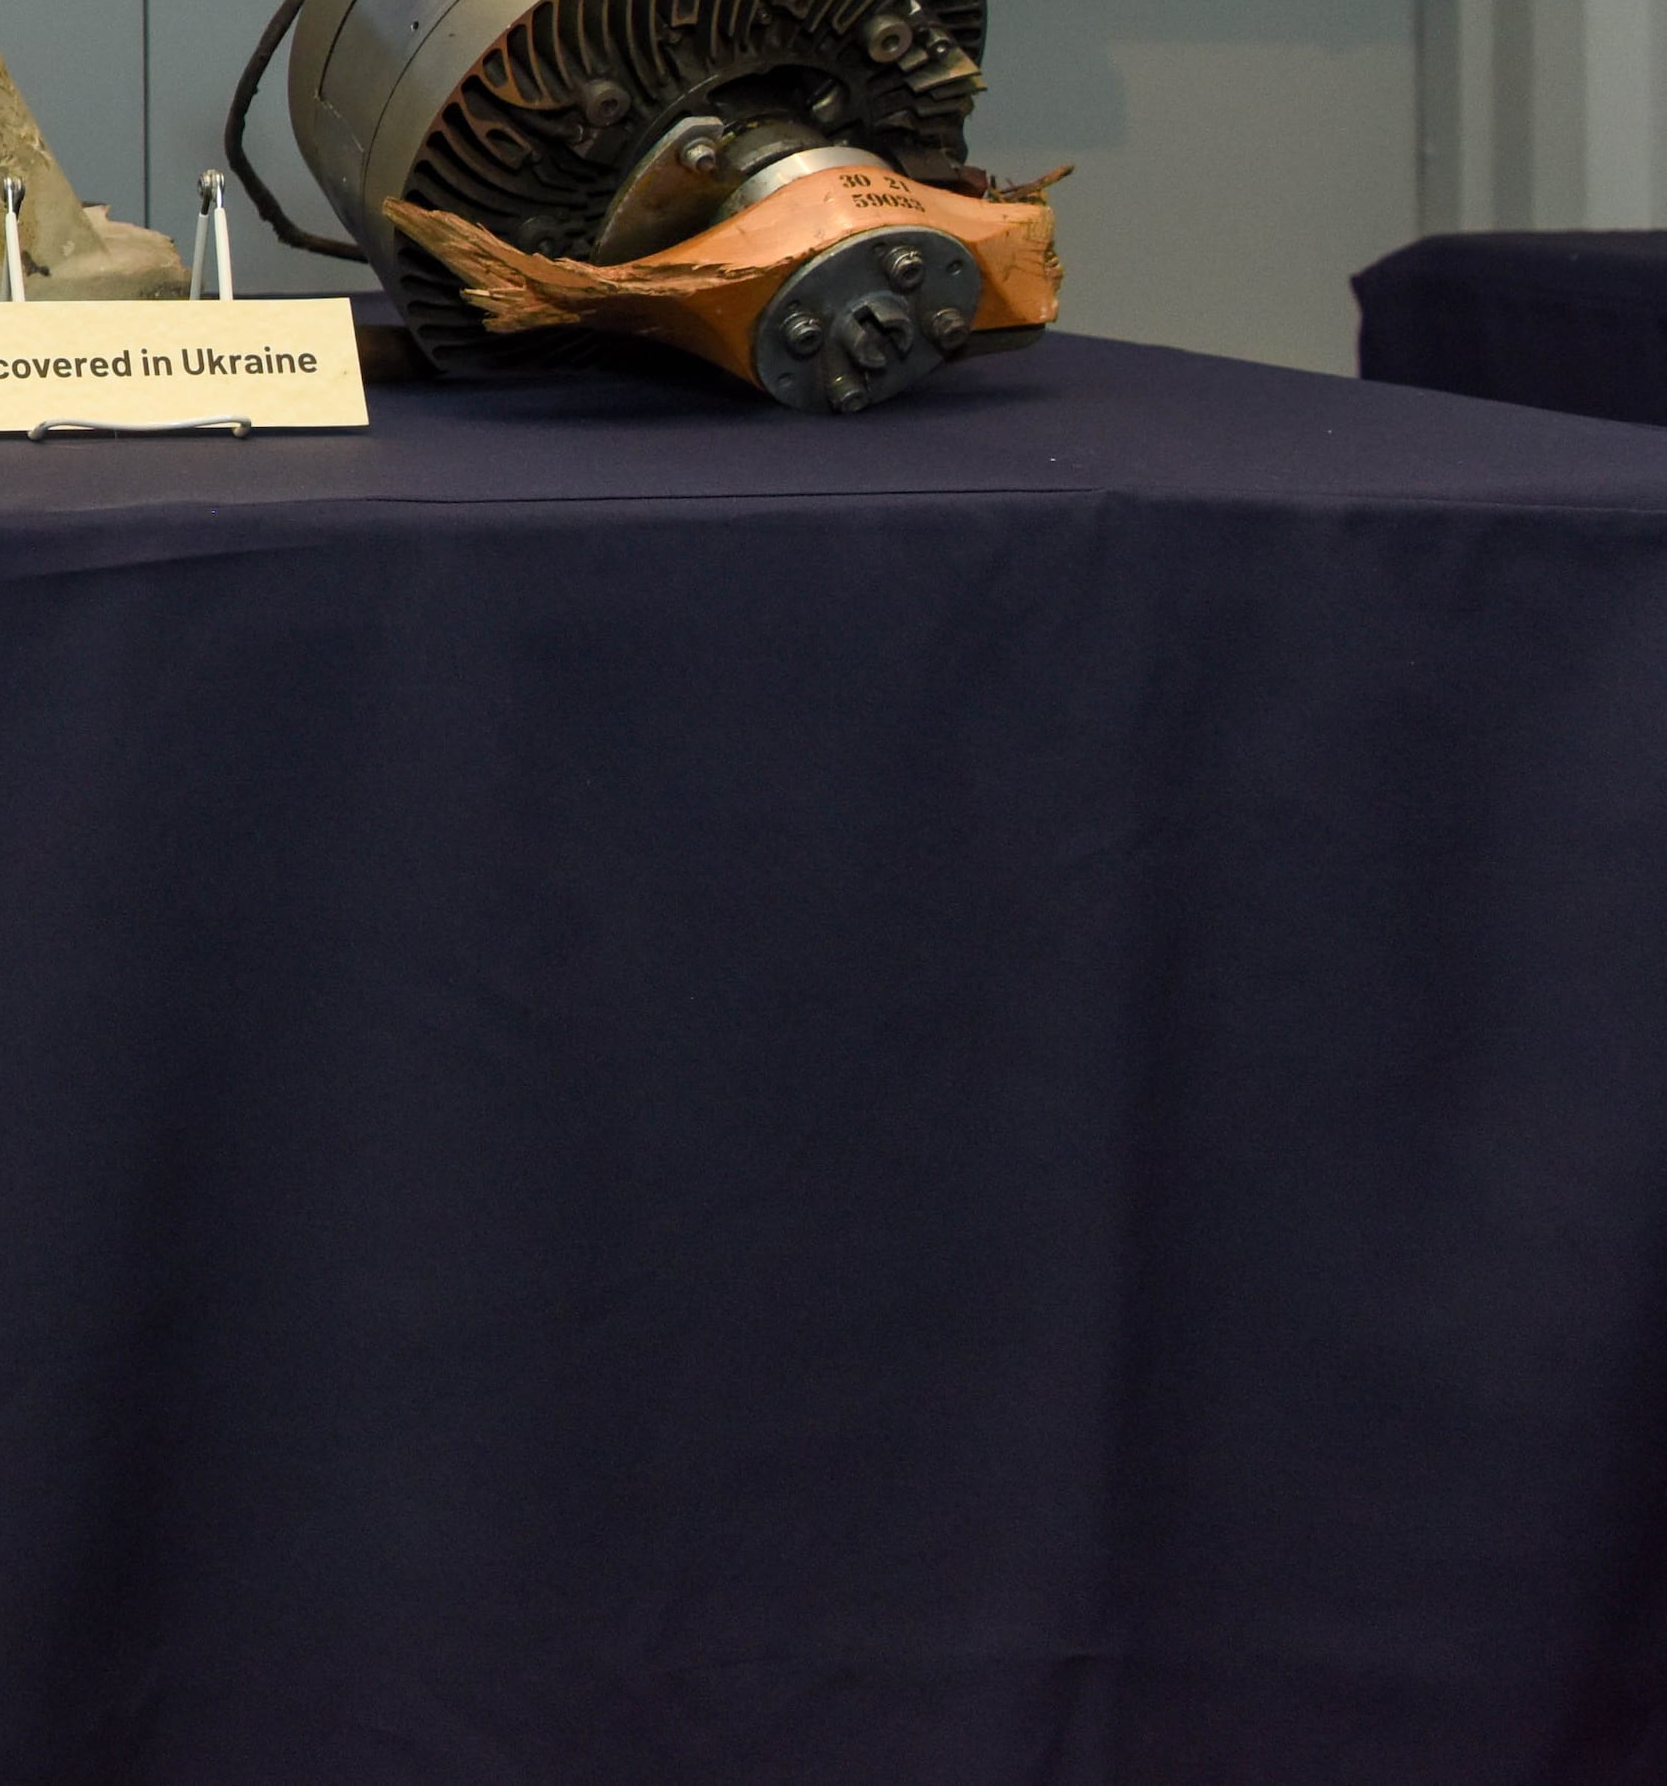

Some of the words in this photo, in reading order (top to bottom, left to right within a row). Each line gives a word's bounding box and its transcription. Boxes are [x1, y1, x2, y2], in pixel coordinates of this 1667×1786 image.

[838, 174, 871, 189] 30
[141, 348, 171, 377] in
[181, 346, 318, 376] Ukraine
